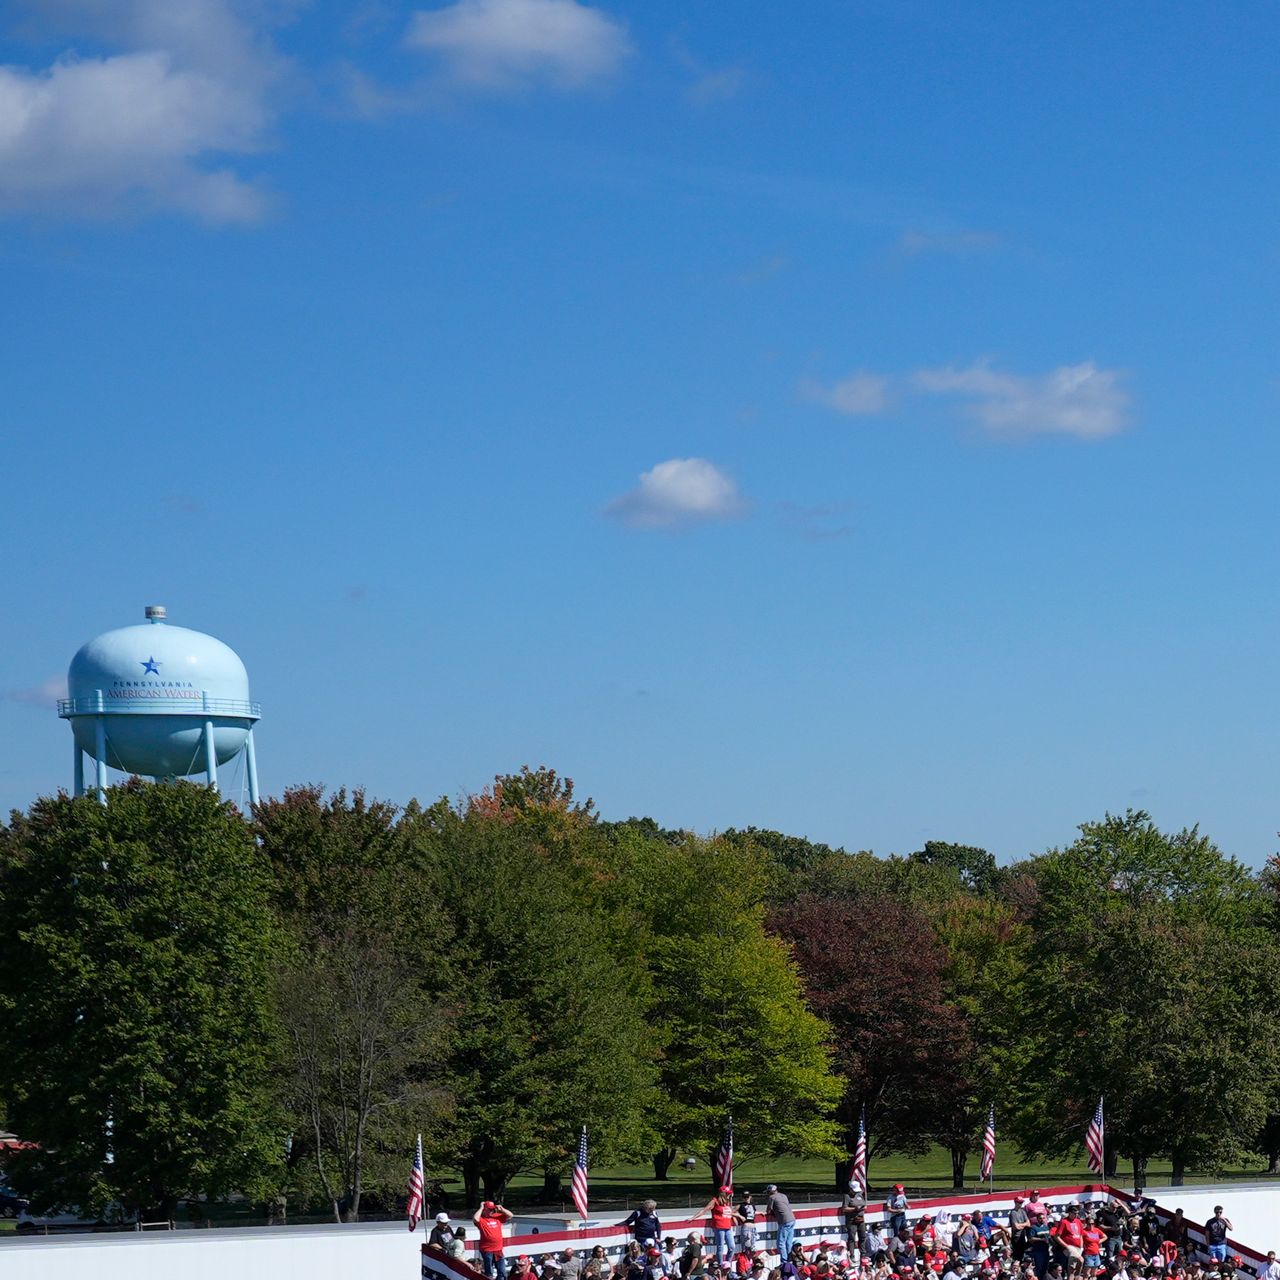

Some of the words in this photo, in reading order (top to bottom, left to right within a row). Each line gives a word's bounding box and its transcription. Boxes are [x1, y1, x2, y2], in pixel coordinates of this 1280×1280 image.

[113, 680, 193, 688] PENNSYLVANIA
[106, 688, 161, 698] AMERICAN
[164, 688, 201, 699] WATER
